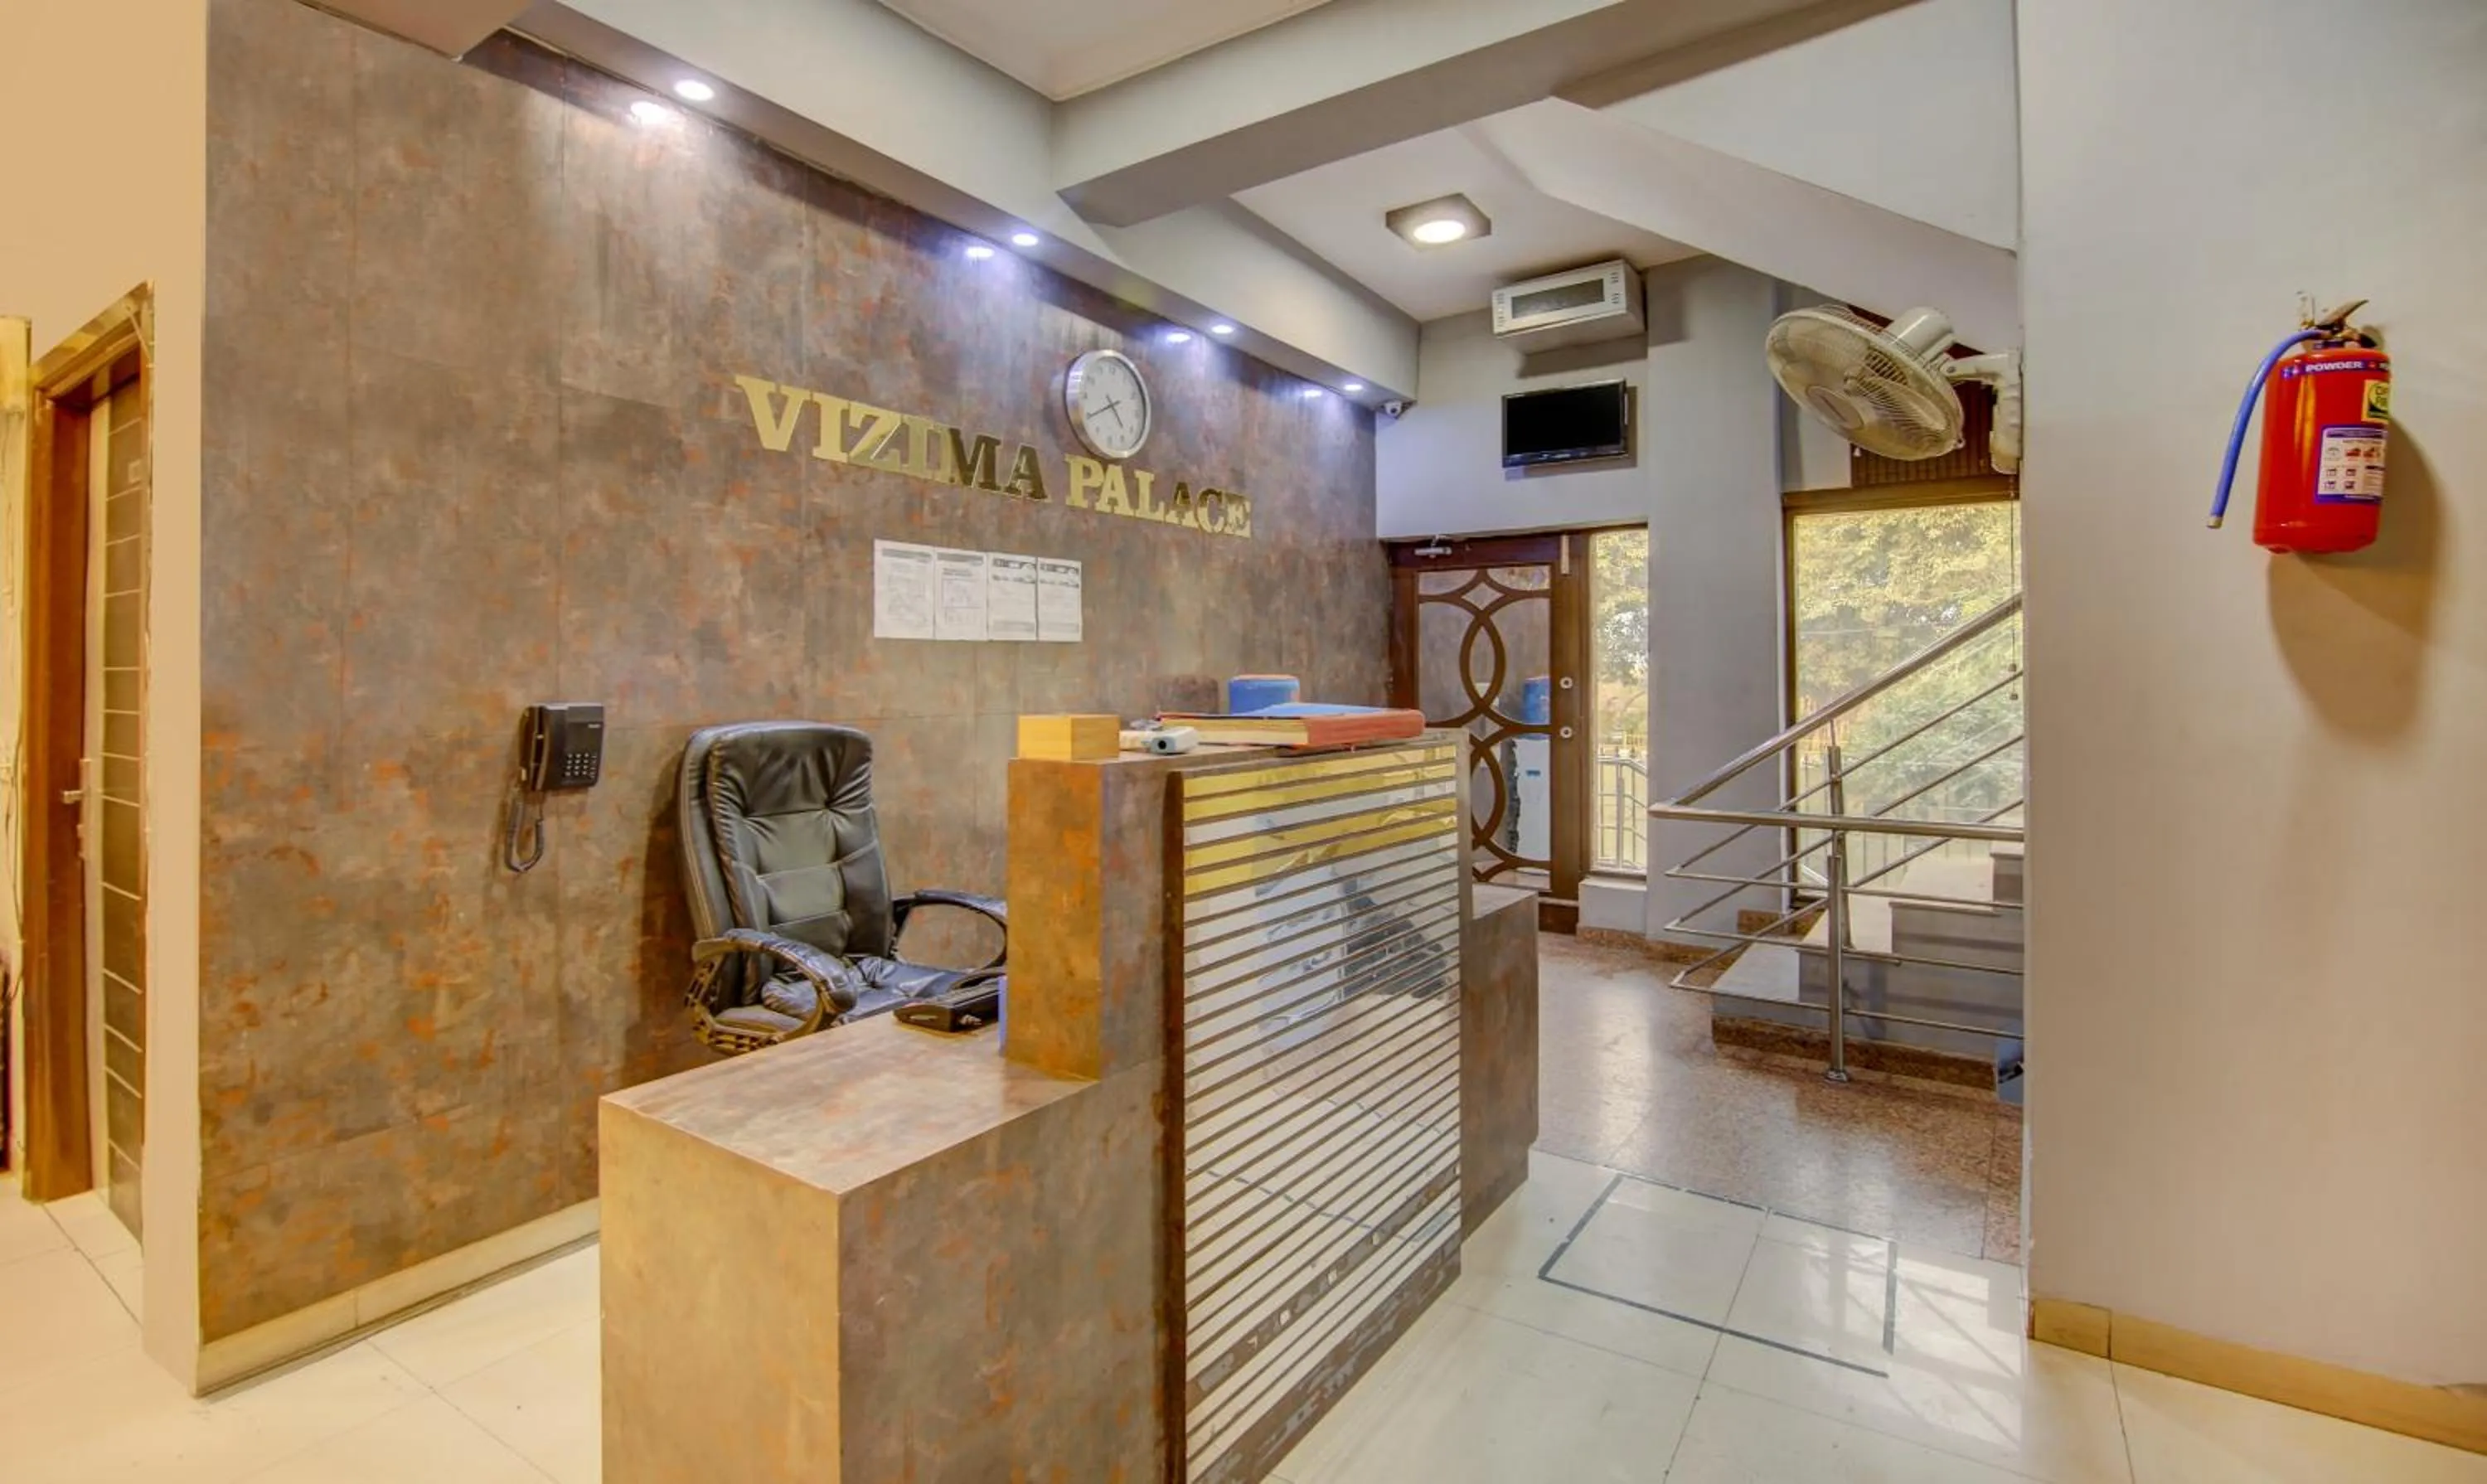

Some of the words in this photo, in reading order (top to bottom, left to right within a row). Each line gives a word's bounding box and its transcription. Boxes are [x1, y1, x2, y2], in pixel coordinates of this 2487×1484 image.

[2305, 361, 2362, 372] POWDER
[734, 375, 1051, 502] VIZIMA
[1064, 453, 1251, 538] PALACE
